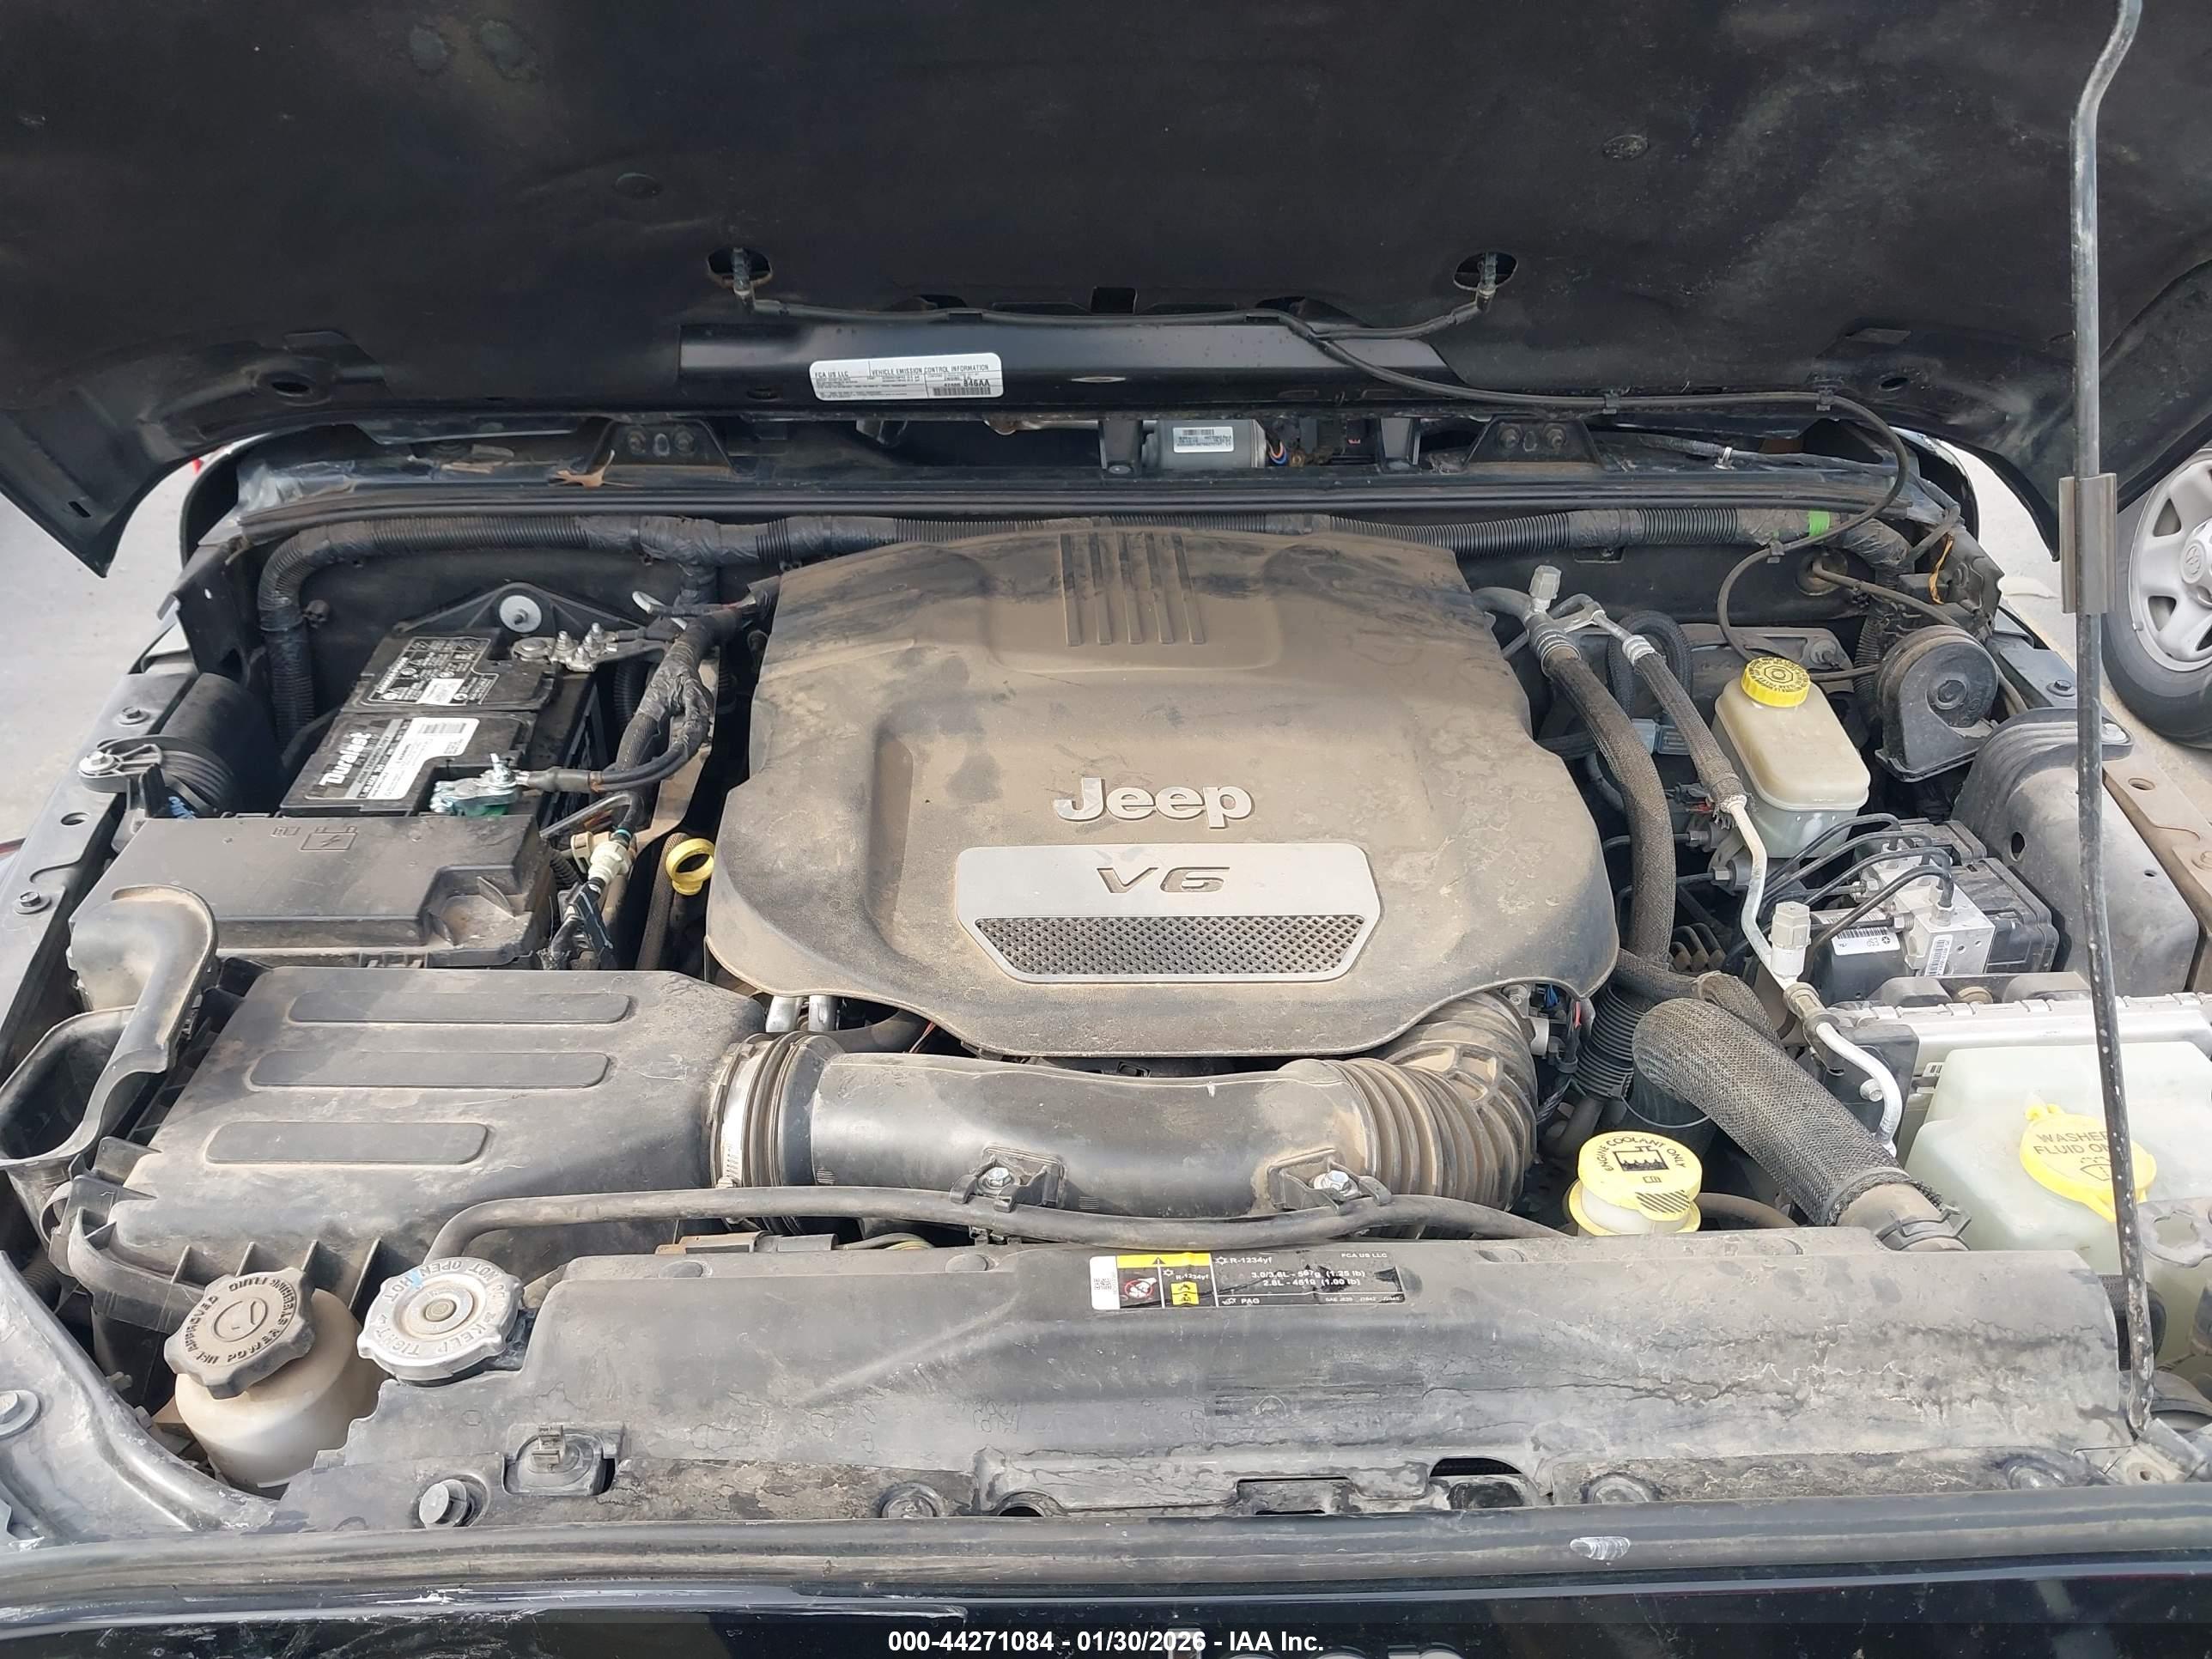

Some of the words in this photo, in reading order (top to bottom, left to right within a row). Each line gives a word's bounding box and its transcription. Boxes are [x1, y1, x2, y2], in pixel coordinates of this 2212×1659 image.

[319, 732, 372, 786] Duralast
[1054, 776, 1254, 830] Jeep
[1096, 866, 1230, 894] V6
[1596, 1145, 1614, 1172] ENGINE
[1606, 1137, 1665, 1148] COOLANT
[1667, 1147, 1686, 1169] ONLY
[2033, 1144, 2085, 1154] FLUID
[419, 1261, 462, 1278] OPEN
[468, 1262, 500, 1280] NOT
[1321, 1278, 1346, 1286] (1.00
[384, 1277, 414, 1302] HOT
[185, 1295, 219, 1352] APPROVED
[227, 1329, 281, 1363] POWER
[375, 1328, 421, 1356] TIGHT
